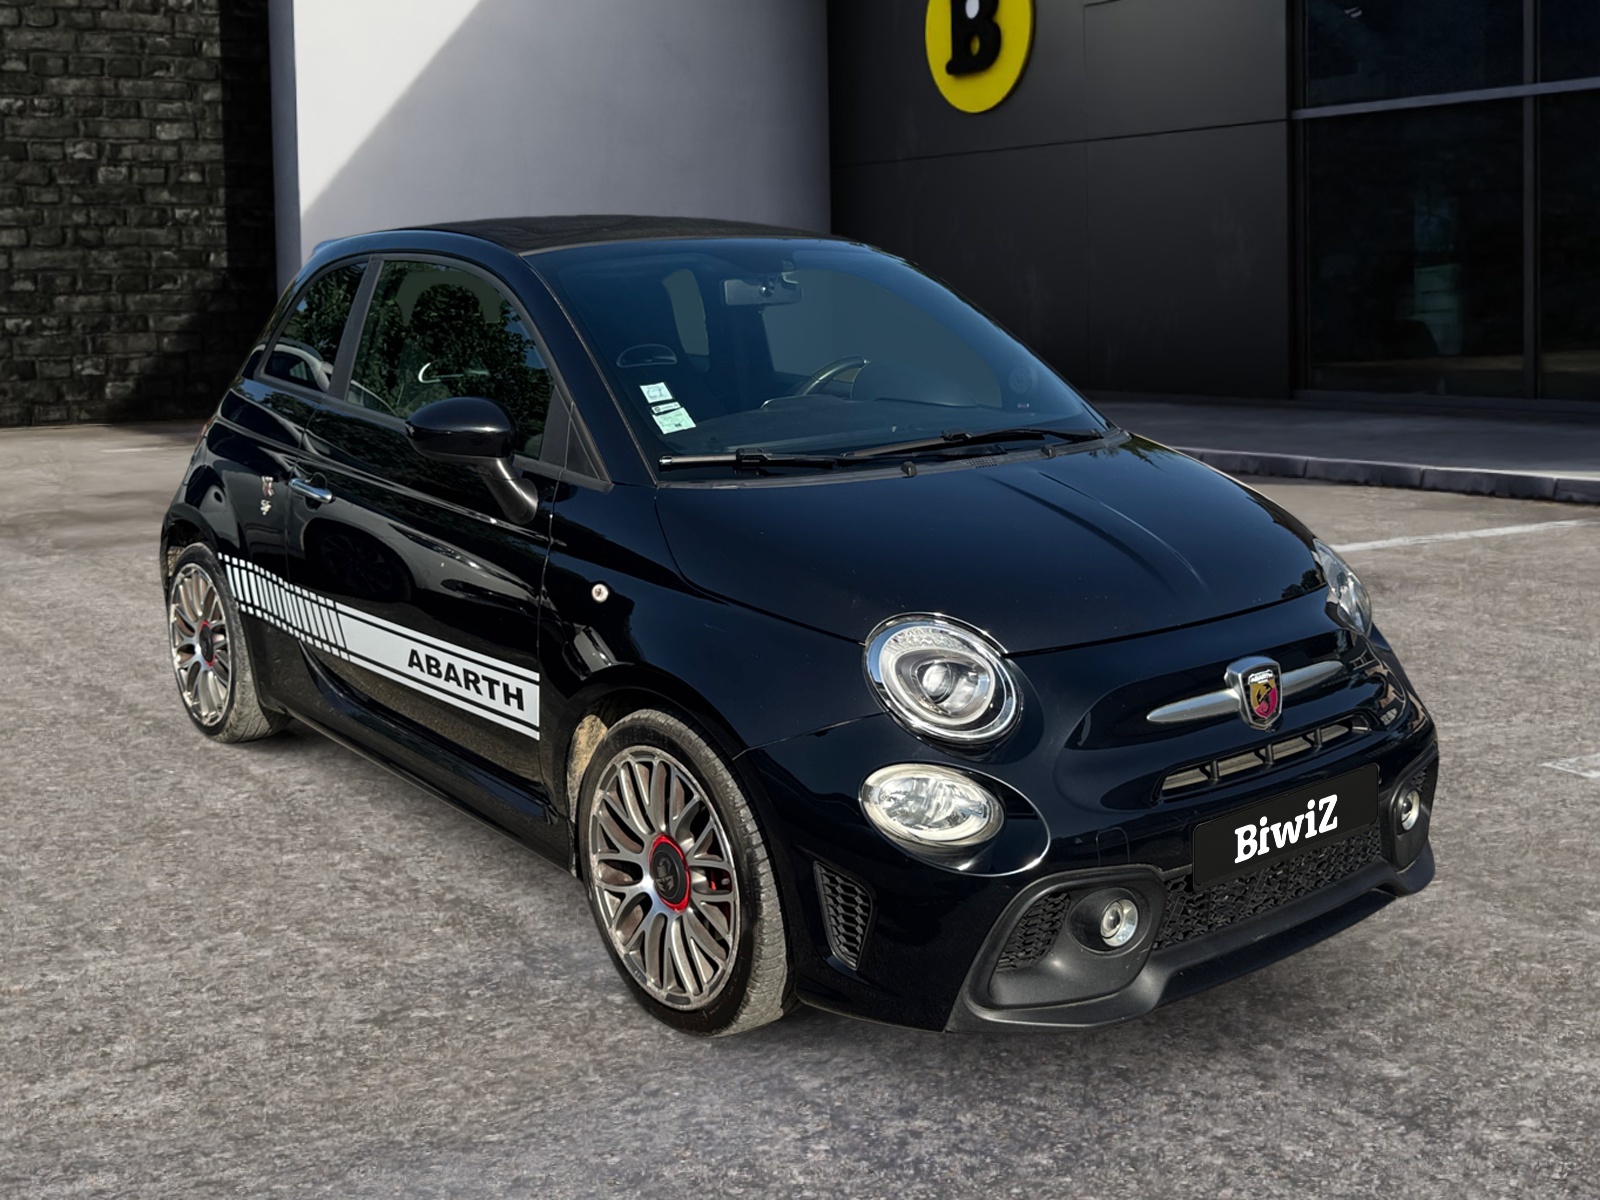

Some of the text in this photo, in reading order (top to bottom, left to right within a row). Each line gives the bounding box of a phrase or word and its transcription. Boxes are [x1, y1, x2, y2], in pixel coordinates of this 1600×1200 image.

[945, 0, 1003, 76] B
[407, 648, 525, 712] ABARTH
[1234, 794, 1338, 864] BiwiZ
